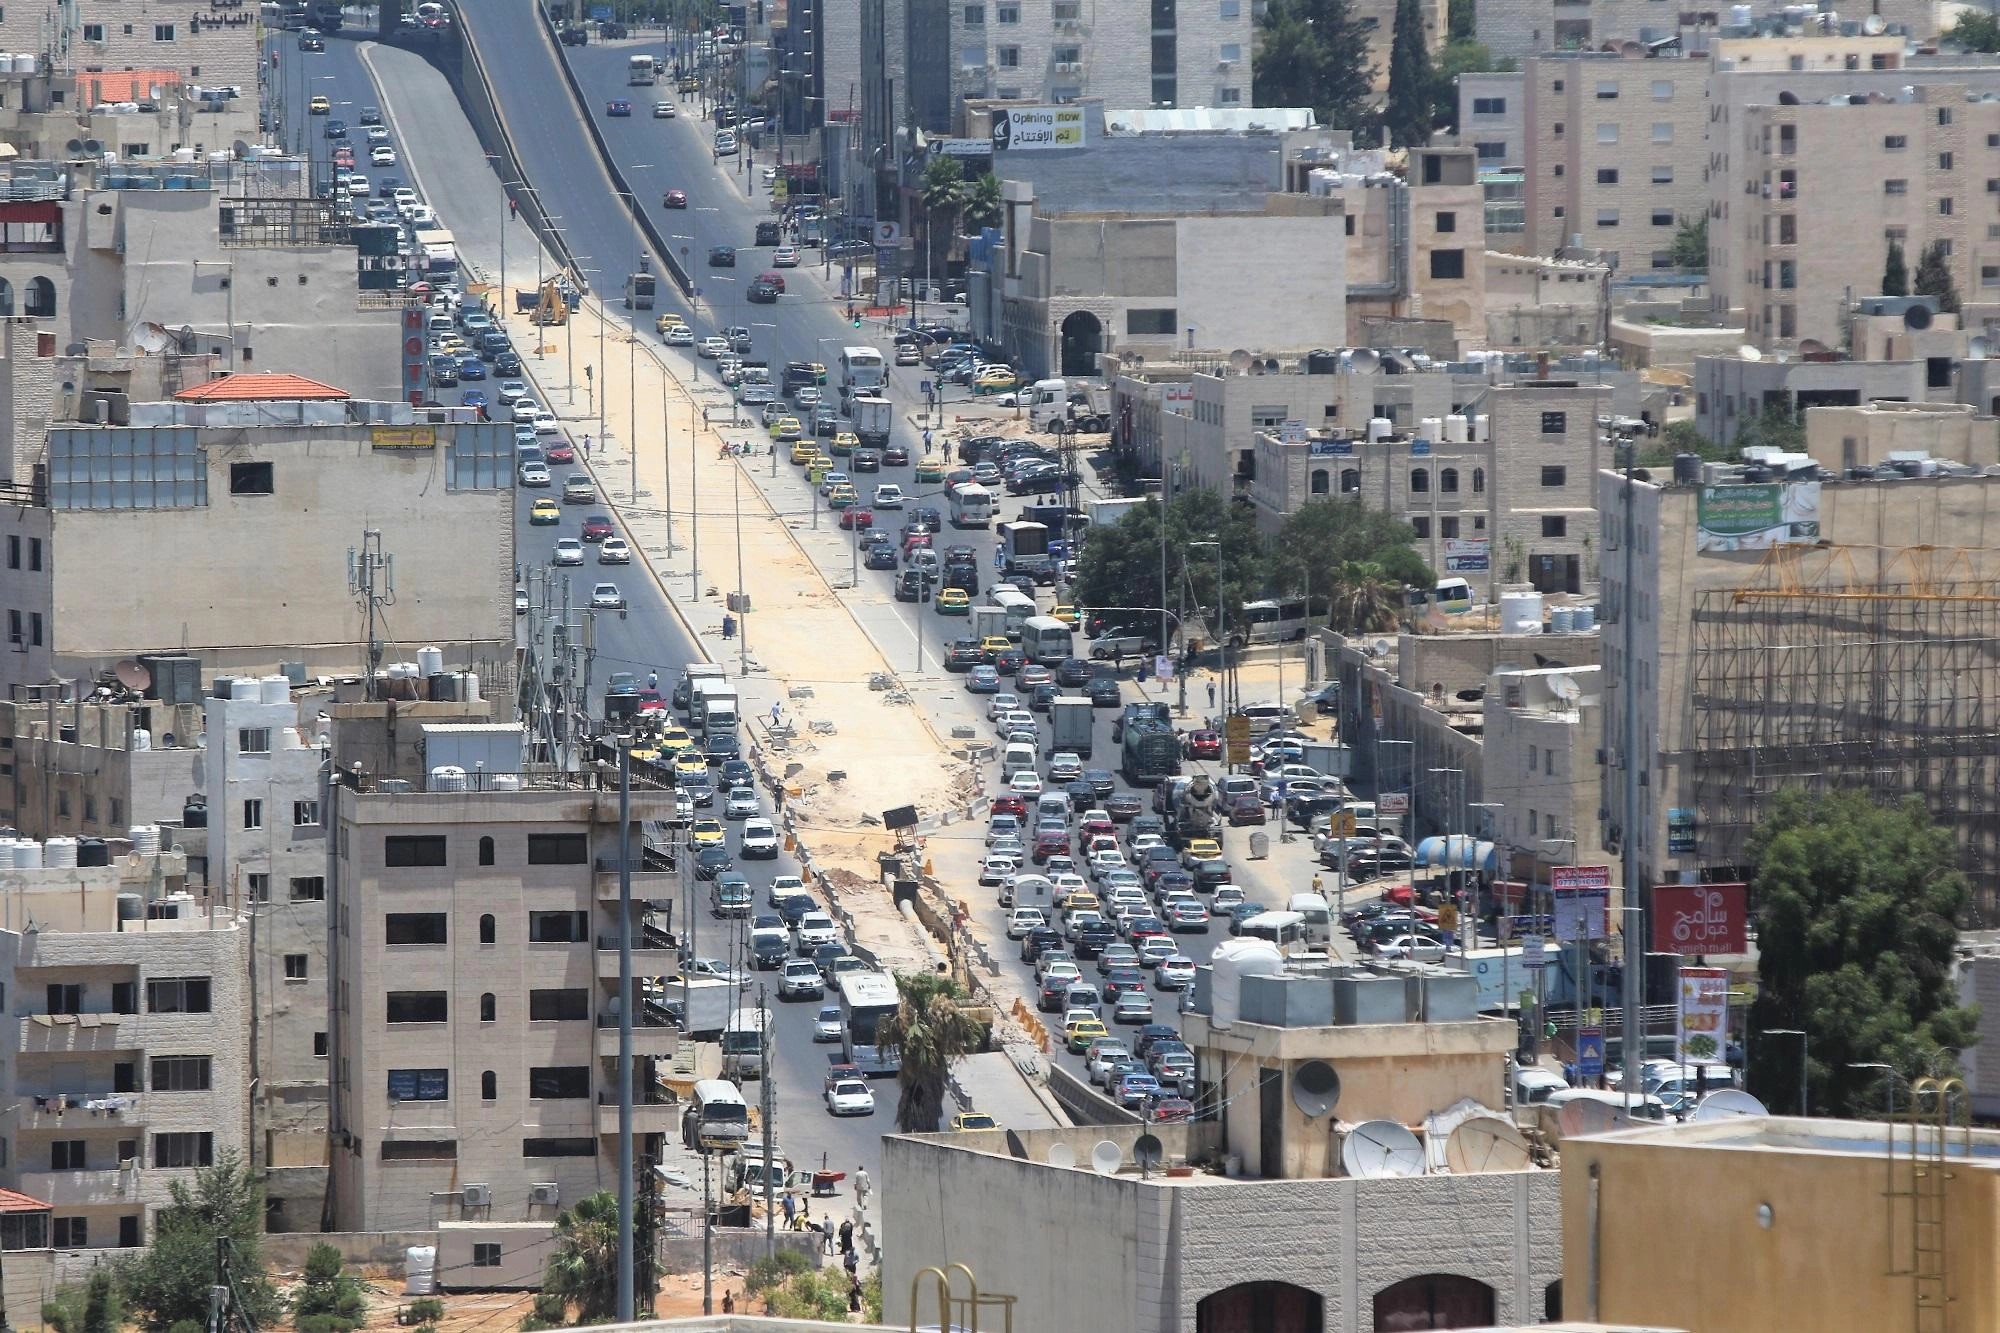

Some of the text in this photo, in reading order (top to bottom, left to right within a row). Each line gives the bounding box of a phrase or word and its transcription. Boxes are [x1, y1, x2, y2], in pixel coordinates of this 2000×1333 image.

[1012, 112, 1080, 125] Opening now
[1013, 129, 1070, 145] تم الإفتتاح
[405, 311, 424, 407] HOTE
[1674, 892, 1728, 941] سامح
[1670, 943, 1732, 954] Sameh mall
